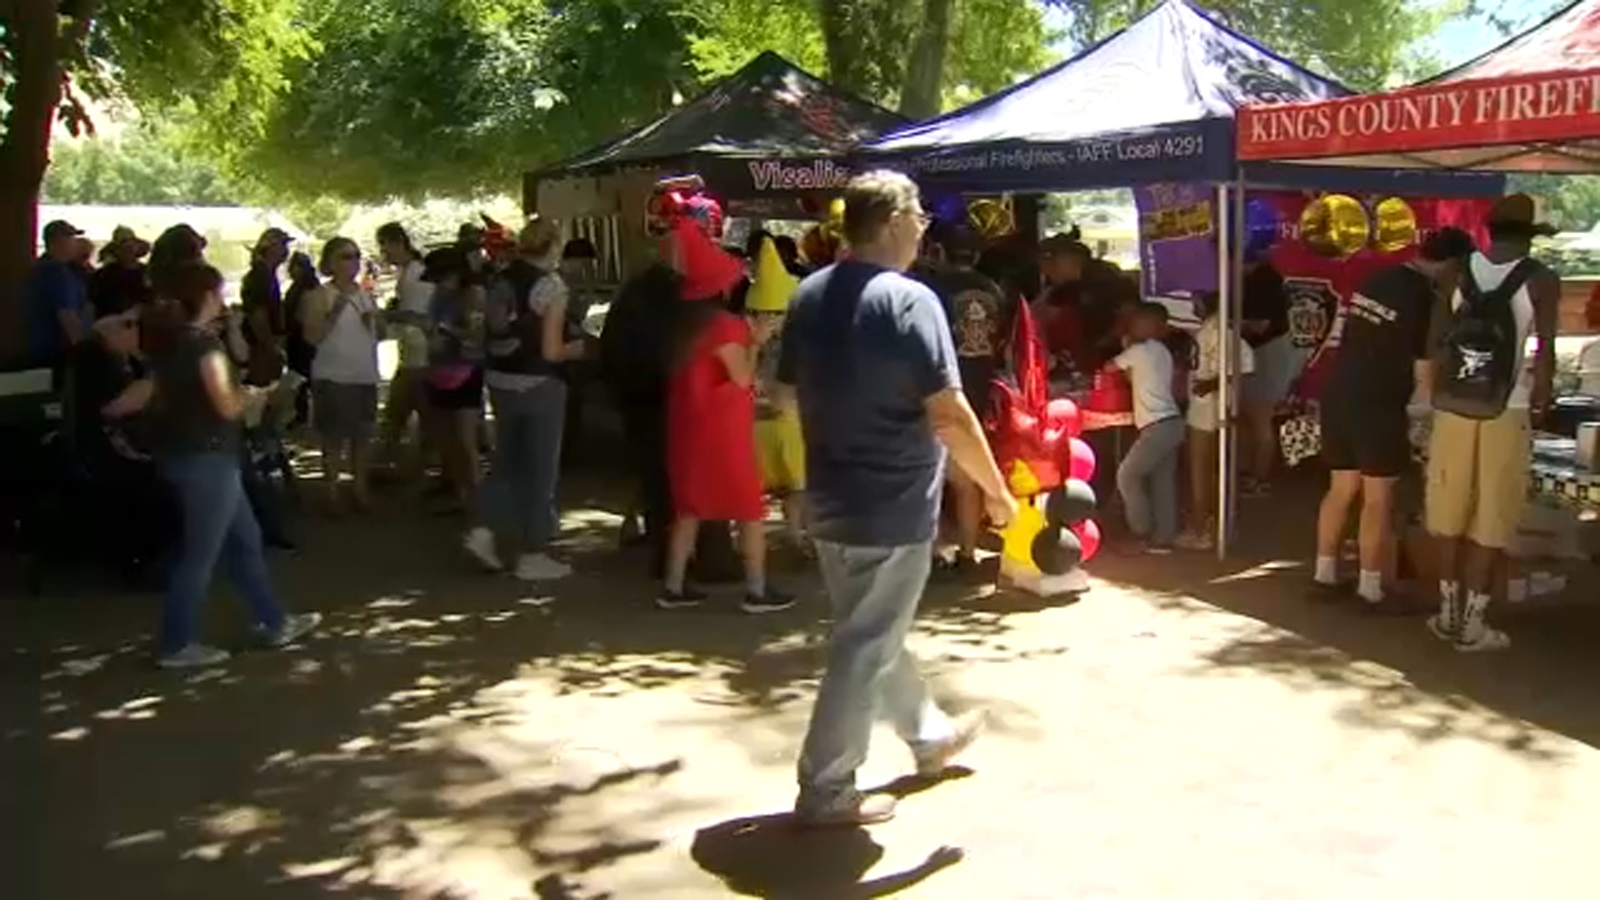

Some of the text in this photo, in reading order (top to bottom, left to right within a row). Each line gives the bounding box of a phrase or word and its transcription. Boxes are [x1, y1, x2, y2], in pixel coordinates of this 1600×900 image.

[1250, 107, 1331, 142] KINGS
[1338, 93, 1470, 136] COUNTY
[989, 147, 1066, 171] Firefighters
[1077, 142, 1111, 162] IAFF
[1117, 142, 1161, 161] Local
[1164, 135, 1204, 157] 4291
